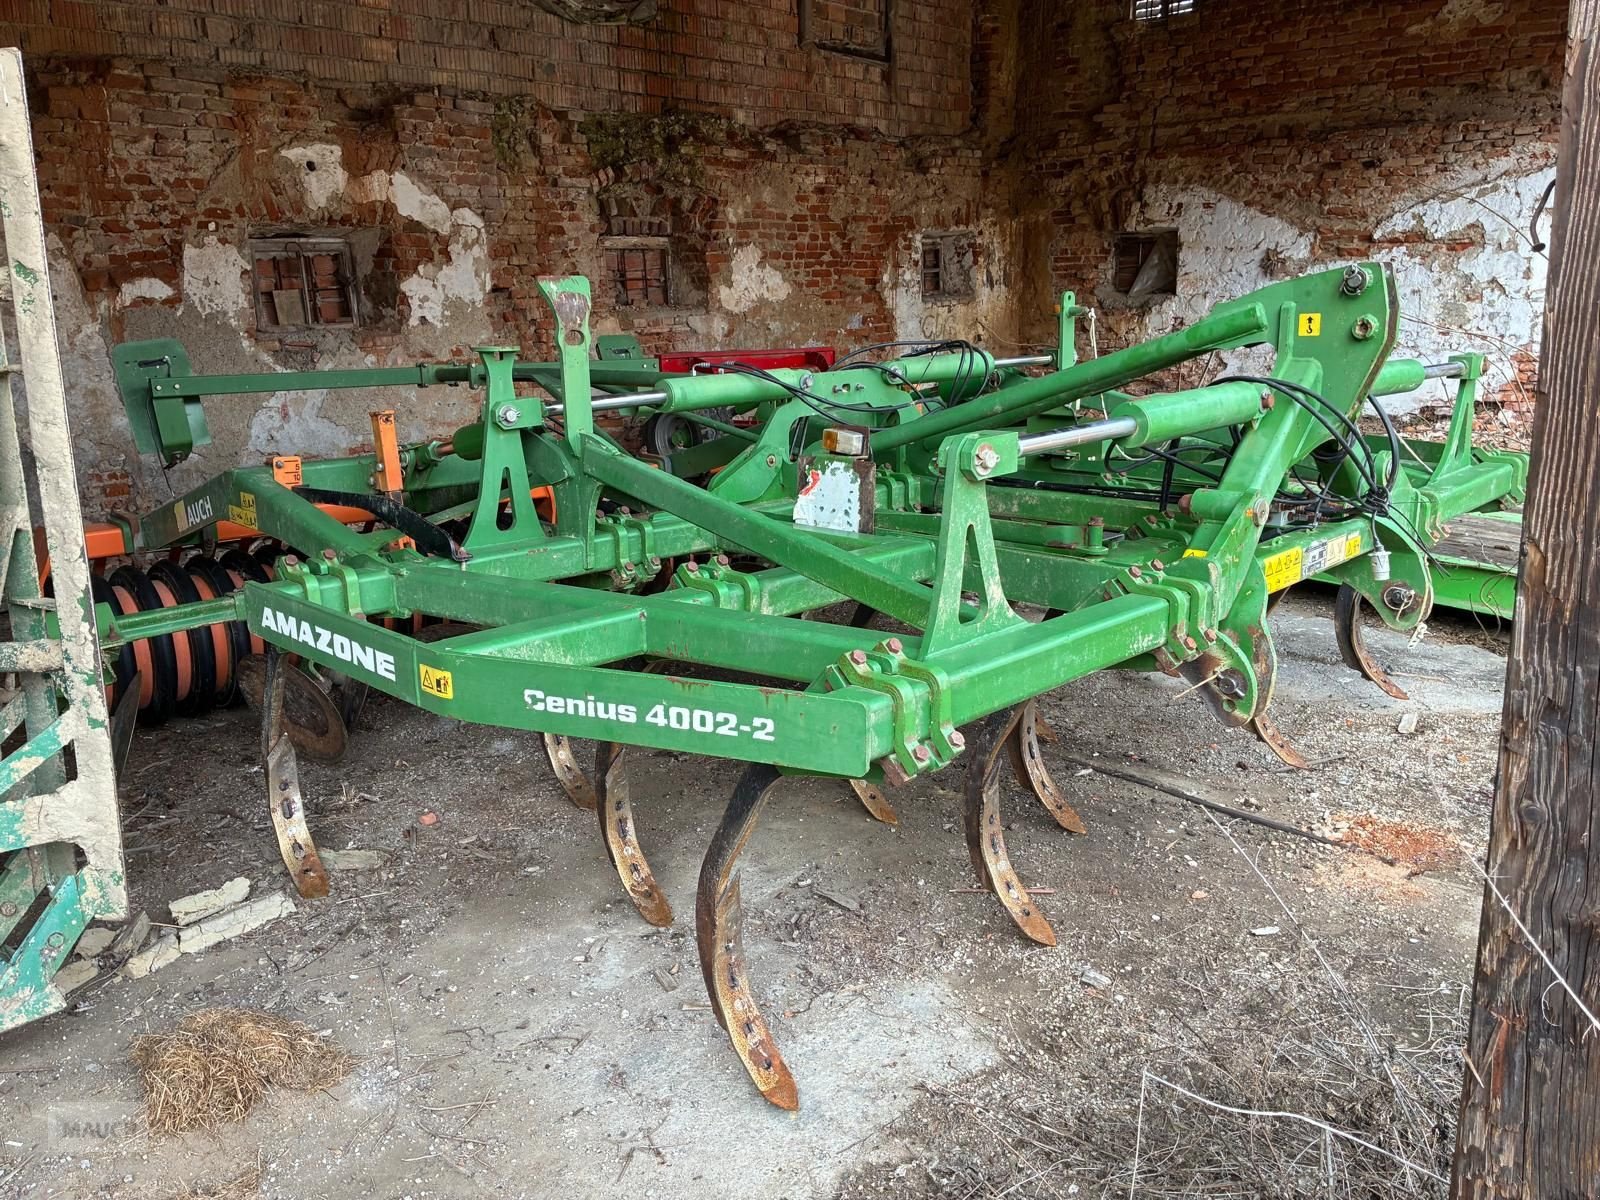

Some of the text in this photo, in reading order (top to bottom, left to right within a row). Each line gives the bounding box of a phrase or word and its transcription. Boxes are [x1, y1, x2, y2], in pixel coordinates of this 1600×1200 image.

[261, 606, 396, 682] AMAZONE
[523, 688, 776, 742] Cenius 4002-2
